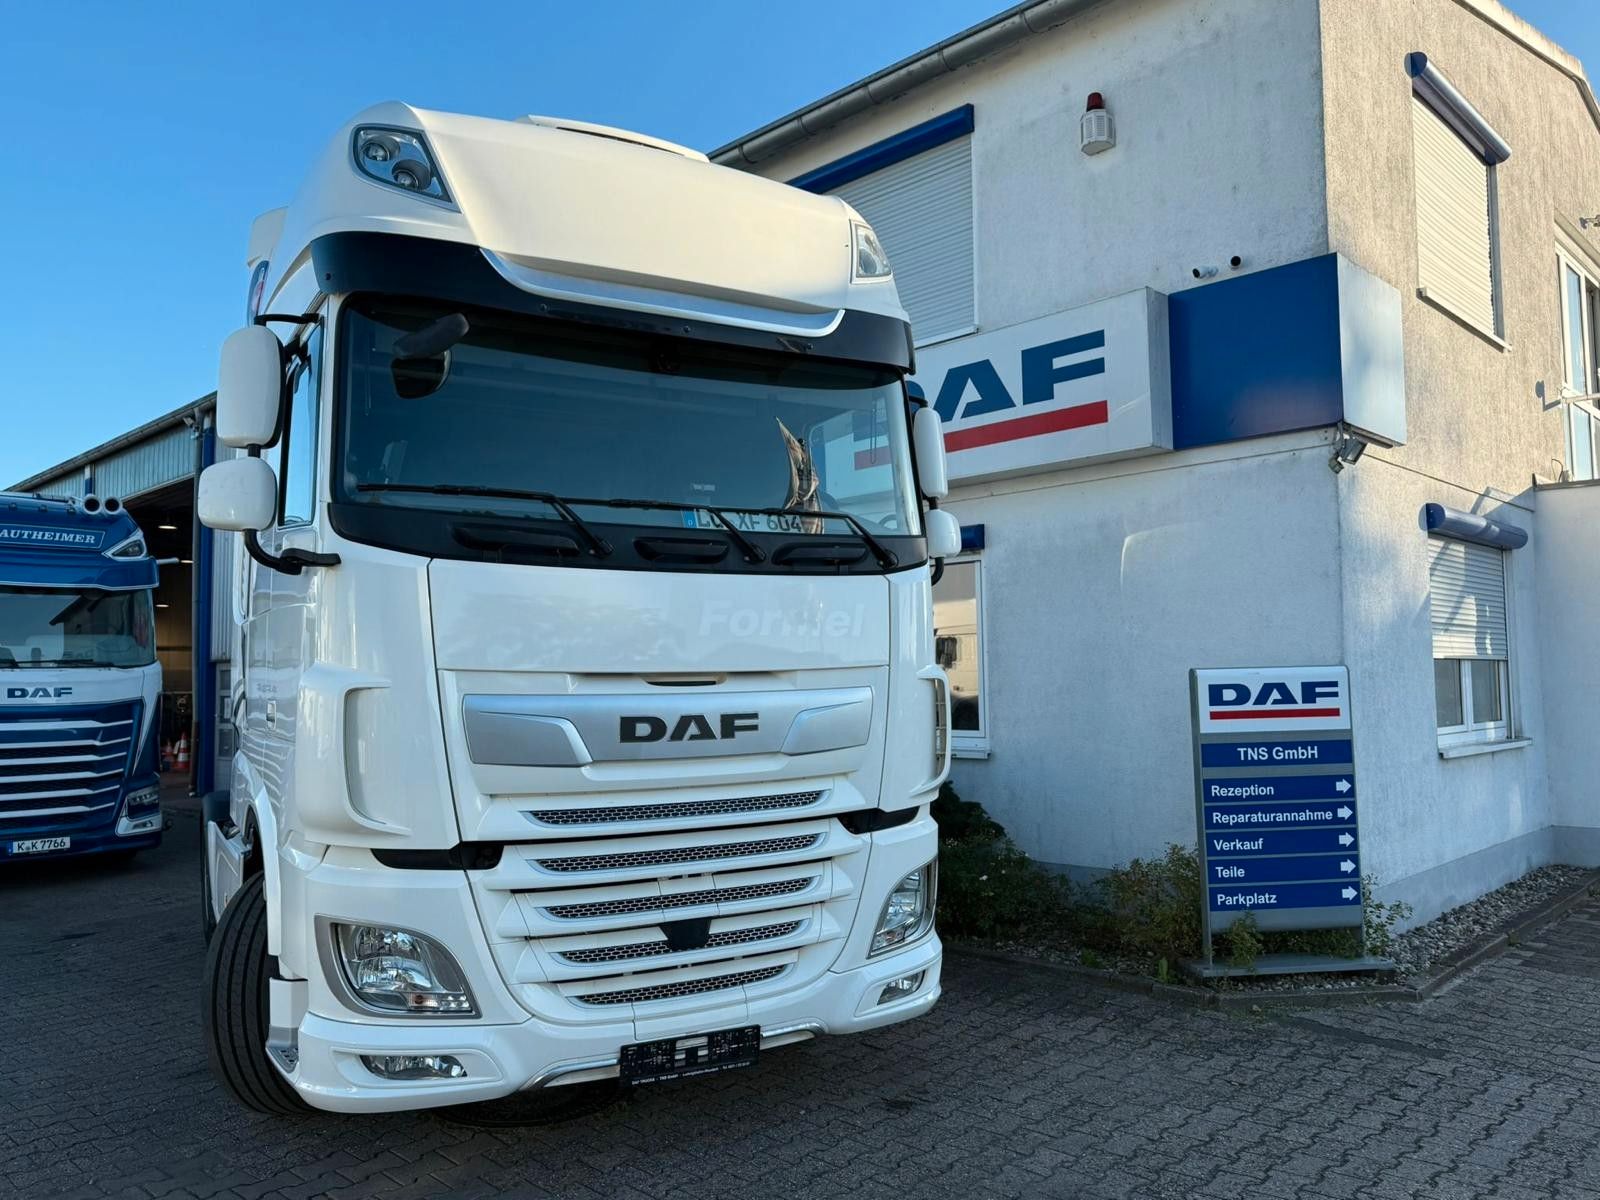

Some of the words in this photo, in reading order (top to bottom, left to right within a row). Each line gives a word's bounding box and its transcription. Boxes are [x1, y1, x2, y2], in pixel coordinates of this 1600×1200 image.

[0, 528, 96, 544] AUTHEIMER
[7, 687, 73, 698] DAF
[1208, 680, 1339, 706] DAF
[619, 712, 760, 744] DAF
[1237, 747, 1269, 761] TNS
[1272, 745, 1319, 760] GmbH
[1211, 783, 1275, 799] Rezeption
[1212, 809, 1333, 826] Reparaturannahme
[17, 841, 25, 851] K
[1213, 838, 1264, 851] Verkauf
[1215, 866, 1246, 879] Teile
[1216, 893, 1278, 907] Parkplatz
